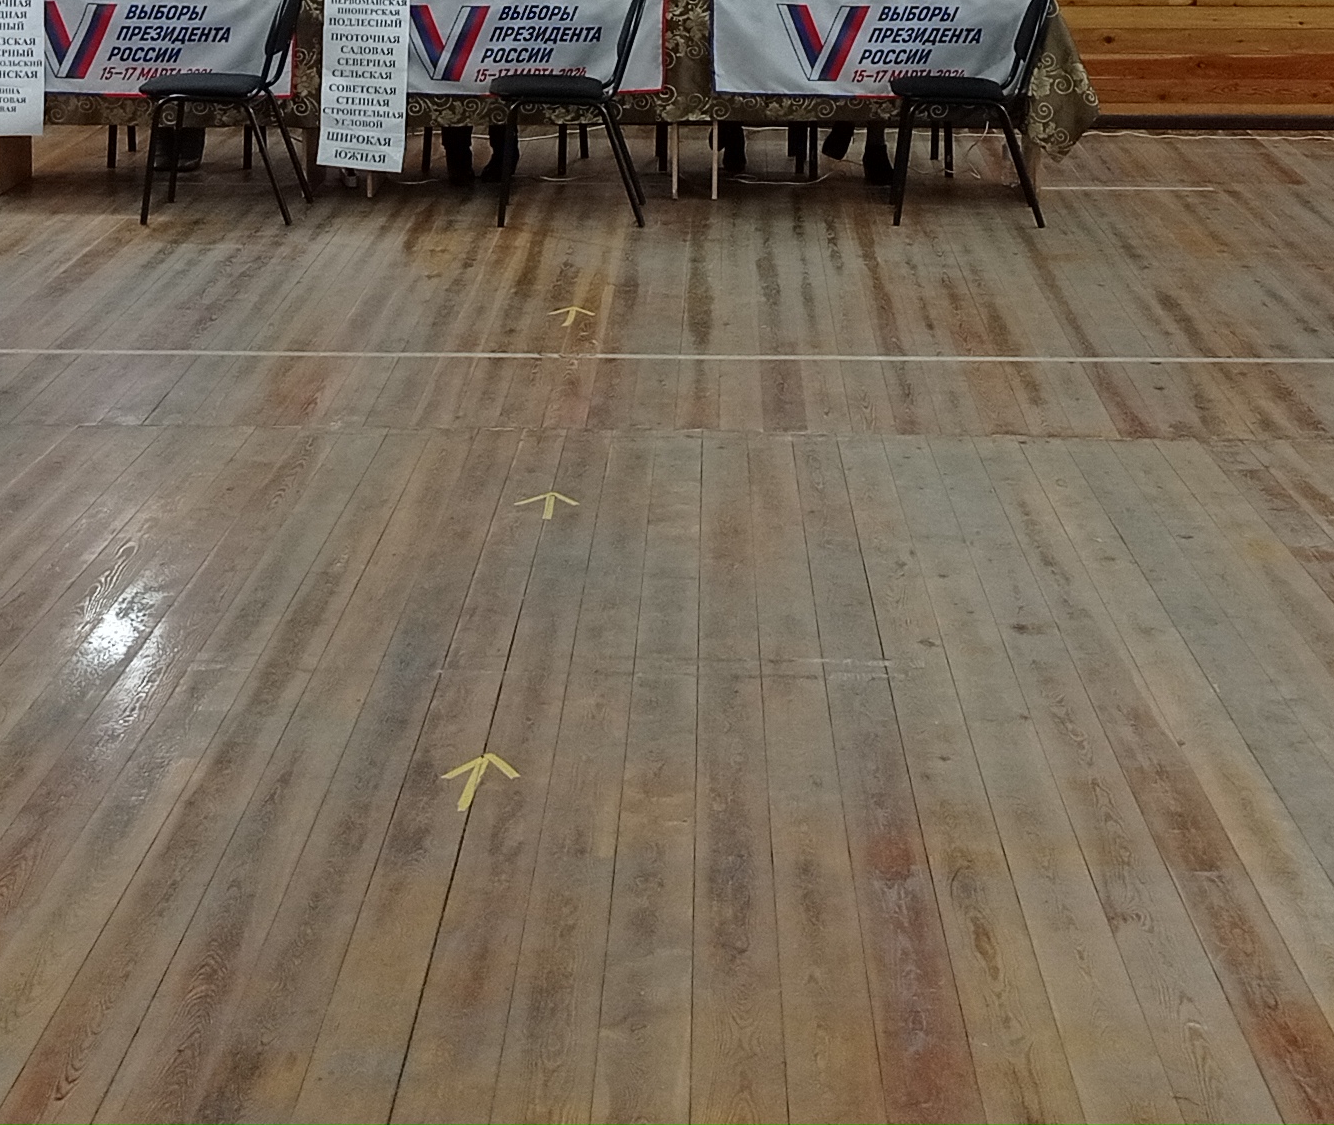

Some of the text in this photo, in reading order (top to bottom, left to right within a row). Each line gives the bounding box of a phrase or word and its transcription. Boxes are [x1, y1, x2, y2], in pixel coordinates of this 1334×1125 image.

[125, 5, 208, 21] ВЫБОРЫ
[337, 7, 401, 16] ПИОНЕРСКАЯ
[498, 5, 579, 22] ВЫБОРЫ
[878, 6, 960, 22] ВЫБОРЫ
[329, 17, 402, 28] ПОДЛЕСНЫЙ
[116, 26, 231, 45] ПРЕЗИДЕНТА
[331, 32, 400, 44] ПРОТОЧНАЯ
[489, 26, 603, 45] ПРЕЗИДЕНТА
[868, 28, 983, 46] ПРЕЗИДЕНТА
[107, 47, 183, 63] РОССИИ
[340, 45, 394, 56] САДОВАЯ
[480, 47, 554, 64] РОССИИ
[858, 49, 933, 65] РОССИИ
[337, 57, 396, 68] СЕВЕРНАЯ
[332, 69, 392, 80] СЕЛЬСКАЯ
[328, 83, 397, 95] СОВЕТСКАЯ
[336, 95, 390, 107] СТЕПНАЯ
[322, 106, 404, 119] СТРОИТЕЛЬНАЯ
[334, 117, 383, 129] УГЛОВОЙ
[327, 131, 392, 147] ШИРОКАЯ
[334, 149, 386, 164] ЮЖНАЯ
